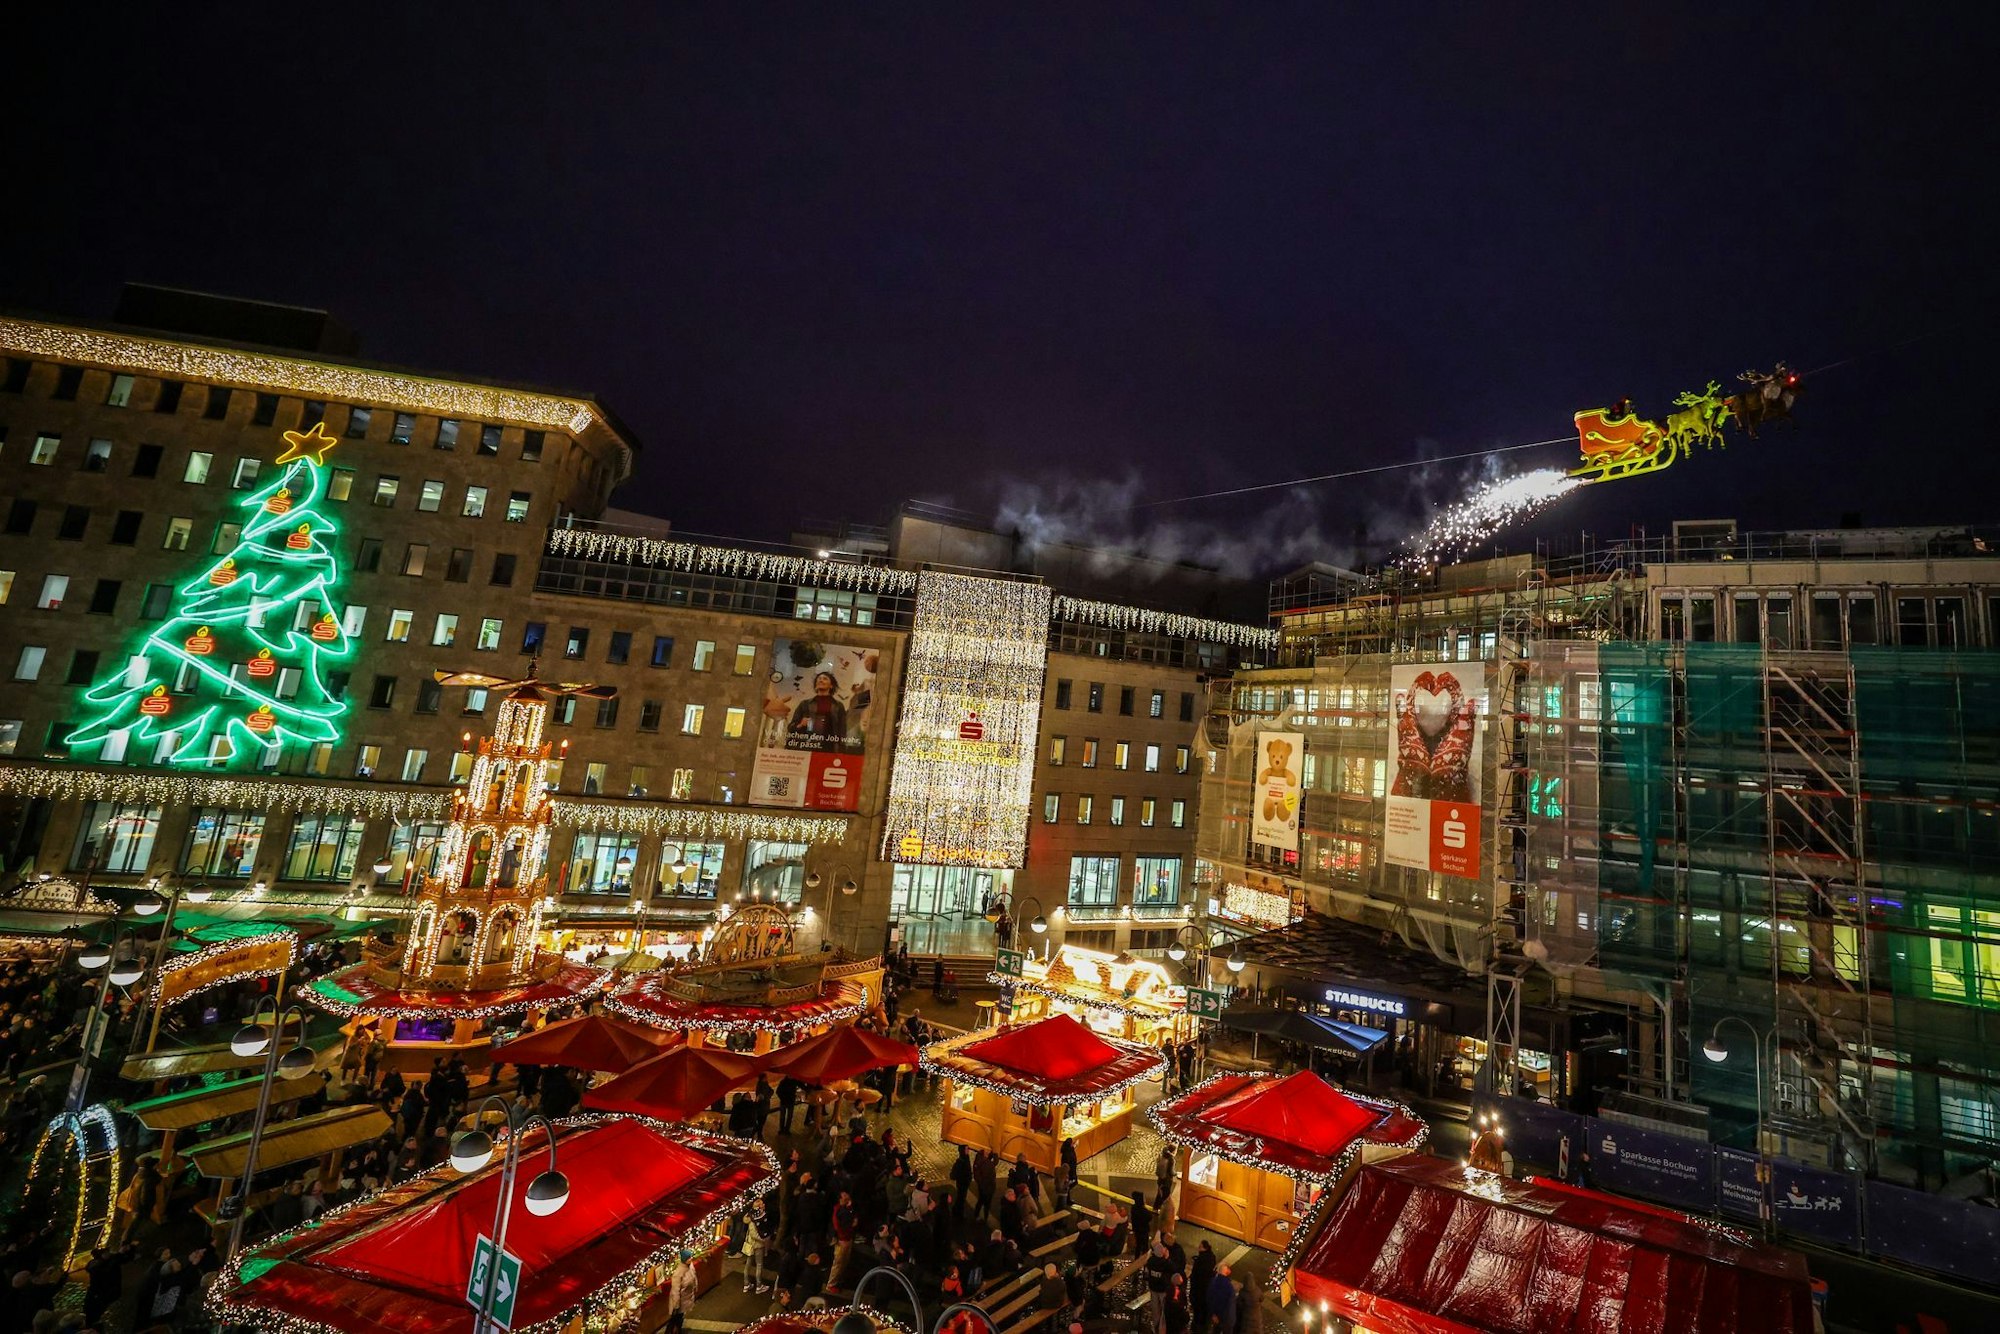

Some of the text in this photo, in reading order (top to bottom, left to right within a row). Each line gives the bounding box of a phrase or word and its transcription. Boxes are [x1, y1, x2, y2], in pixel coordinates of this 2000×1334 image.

[810, 733, 825, 741] den
[826, 735, 840, 743] Job
[930, 844, 1009, 862] Sparkasse
[1440, 853, 1468, 864] Sparkasse
[1442, 862, 1465, 872] Bochum
[1001, 993, 1012, 1003] WC
[1325, 989, 1404, 1014] STARBUCKS
[1620, 1148, 1662, 1165] Sparkasse
[1663, 1158, 1698, 1173] Bochum
[1729, 1153, 1755, 1163] BOCHUM
[1722, 1180, 1762, 1196] Bochumer
